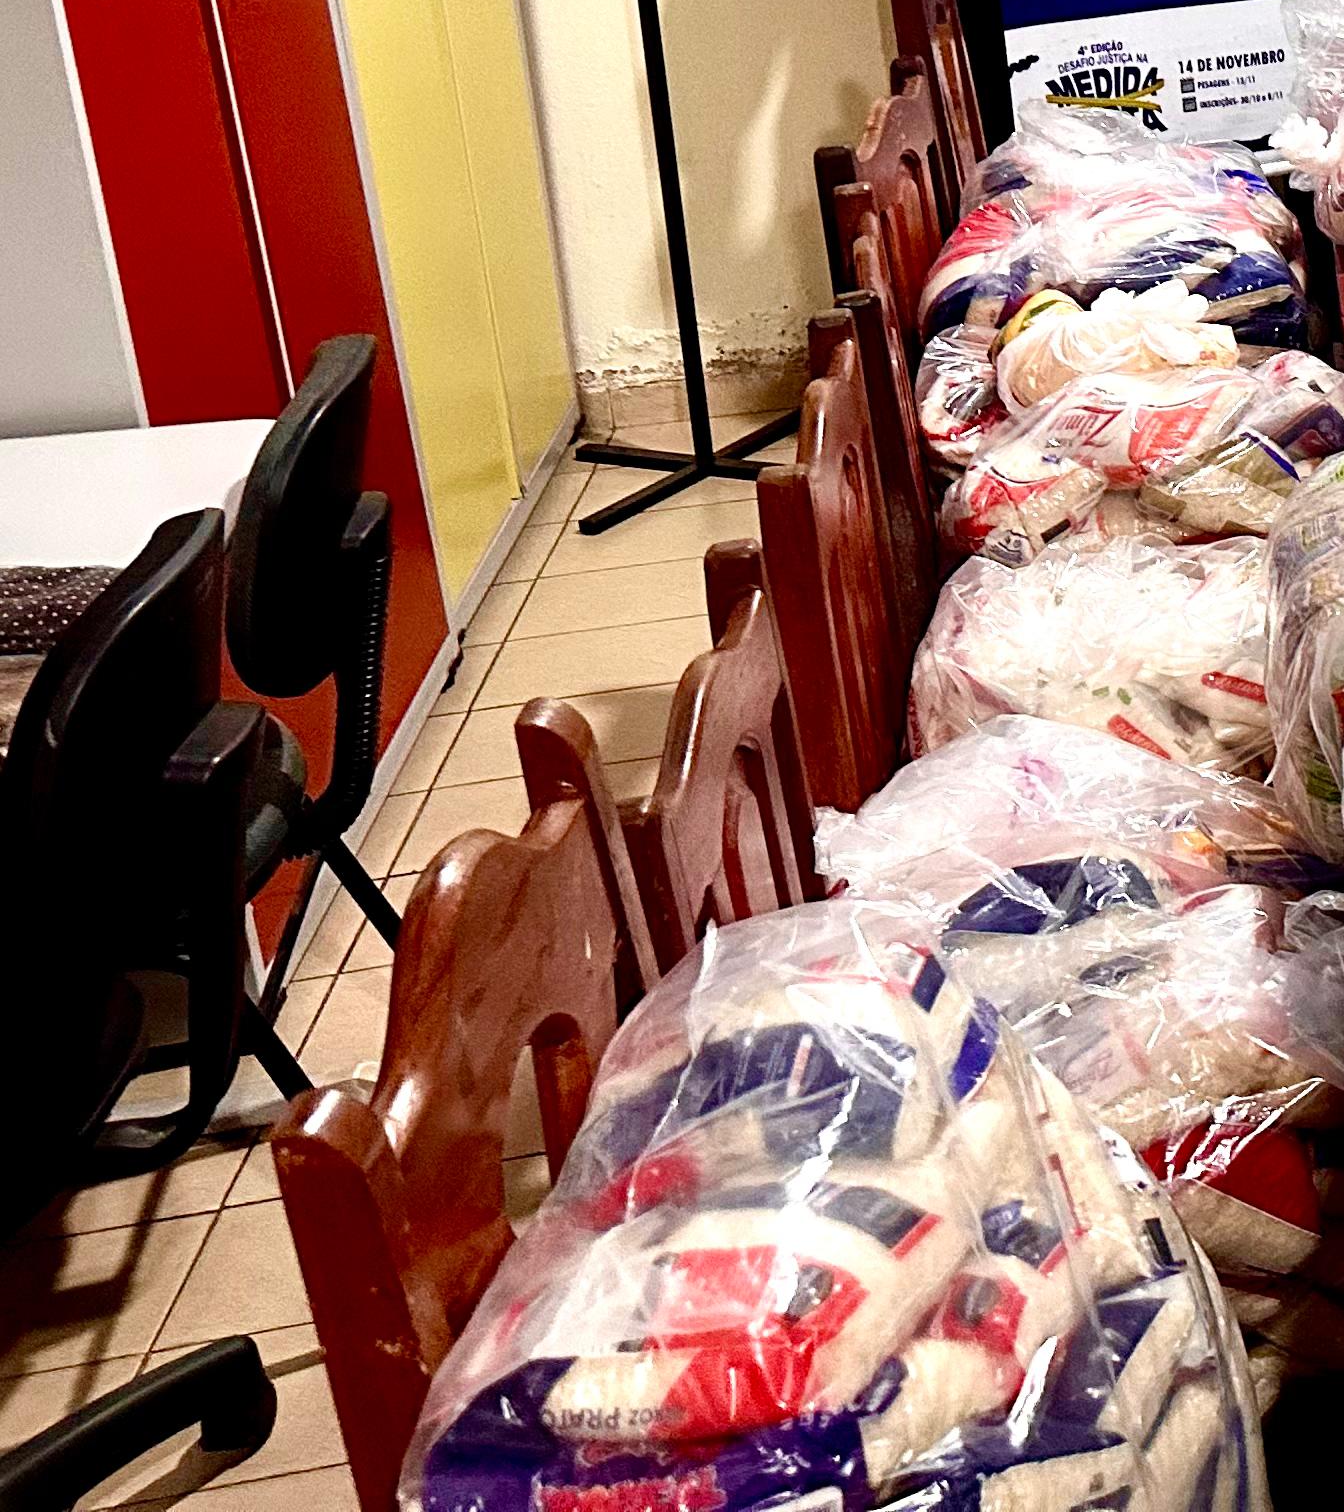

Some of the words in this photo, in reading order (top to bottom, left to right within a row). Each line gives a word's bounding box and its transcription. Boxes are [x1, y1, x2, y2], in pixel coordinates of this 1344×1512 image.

[1090, 40, 1123, 55] EDIÇÃO
[1057, 56, 1095, 75] DESAFIO
[1096, 51, 1134, 66] JUSTIÇA
[1136, 52, 1148, 65] NA
[1178, 59, 1194, 74] 14
[1197, 57, 1213, 72] DE
[1215, 48, 1285, 70] NOVEMBRO
